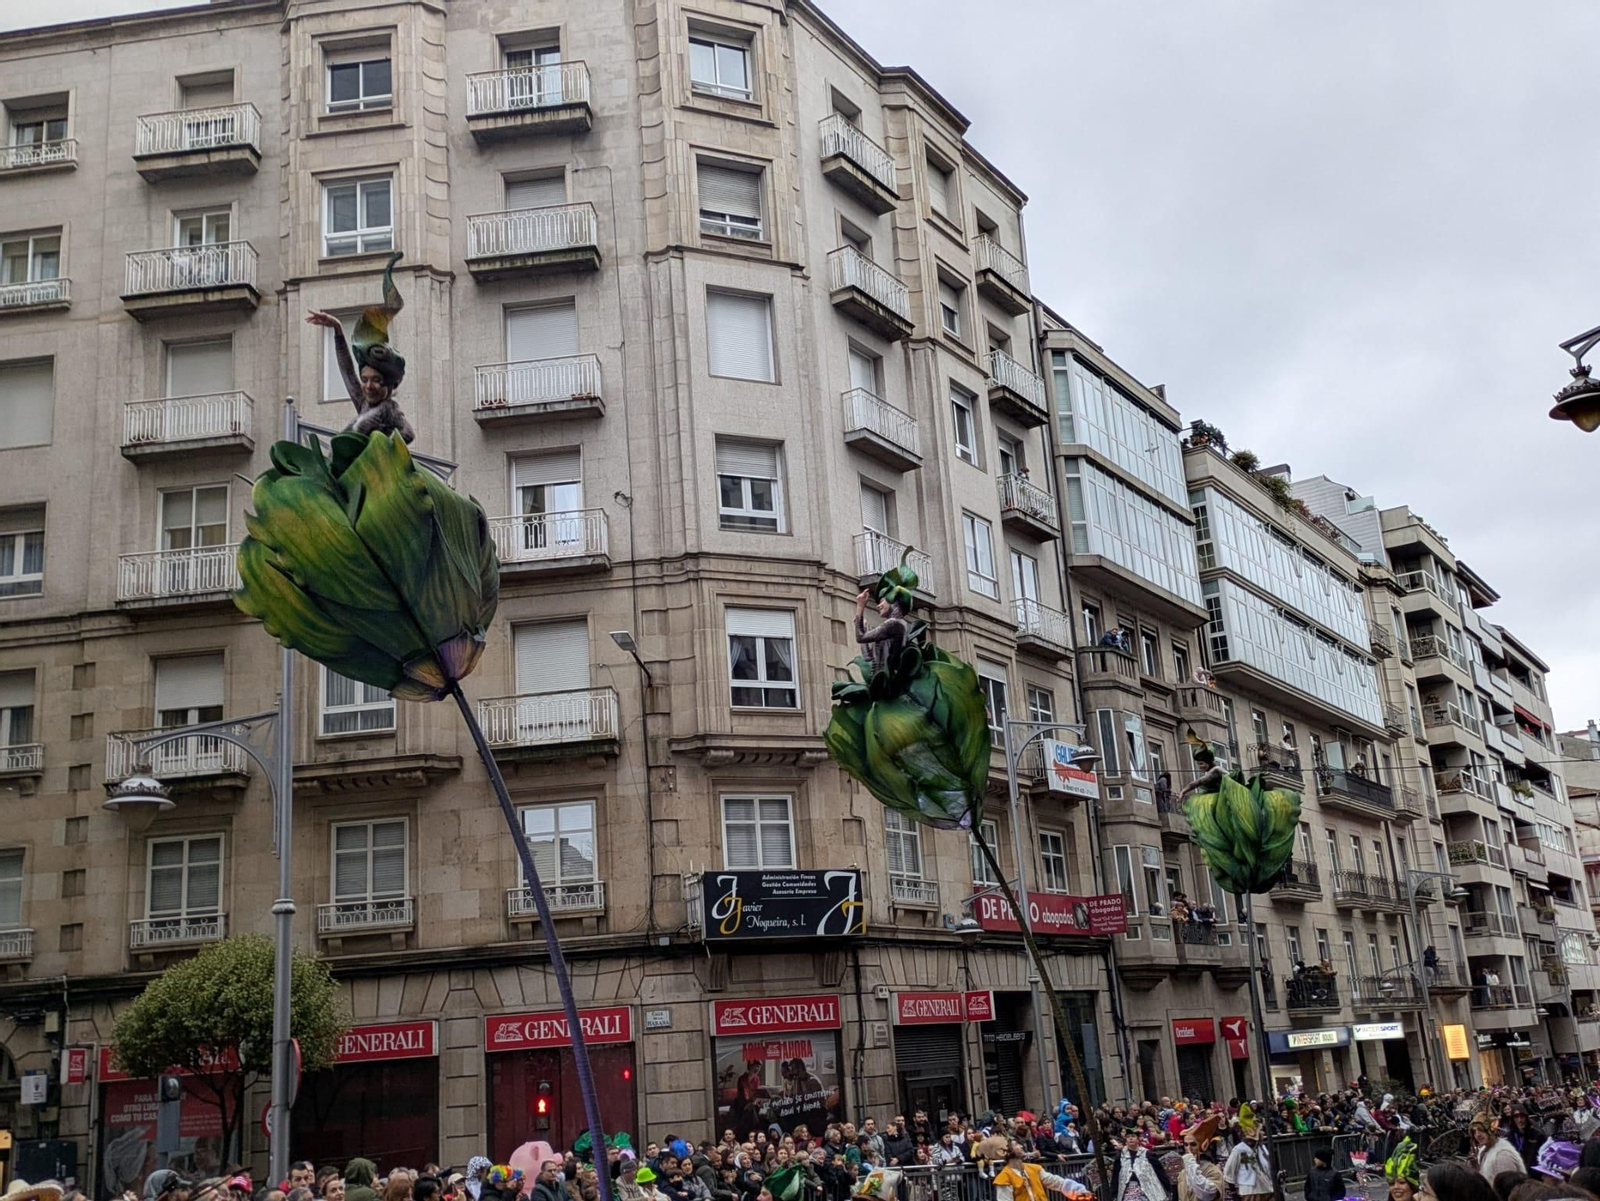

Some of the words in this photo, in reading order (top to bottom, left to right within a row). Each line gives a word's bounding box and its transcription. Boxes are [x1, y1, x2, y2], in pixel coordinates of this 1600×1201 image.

[1091, 906, 1122, 914] abogados
[1099, 898, 1122, 906] PRADO
[981, 897, 999, 920] DE
[1000, 899, 1040, 923] PRO
[1042, 907, 1074, 928] abogados
[748, 1002, 836, 1025] GENERALI
[915, 999, 960, 1017] GENERALI
[524, 1015, 622, 1041] GENRALI
[783, 1039, 813, 1058] AHORA
[143, 1102, 159, 1111] LUGA
[143, 1112, 158, 1121] CAS
